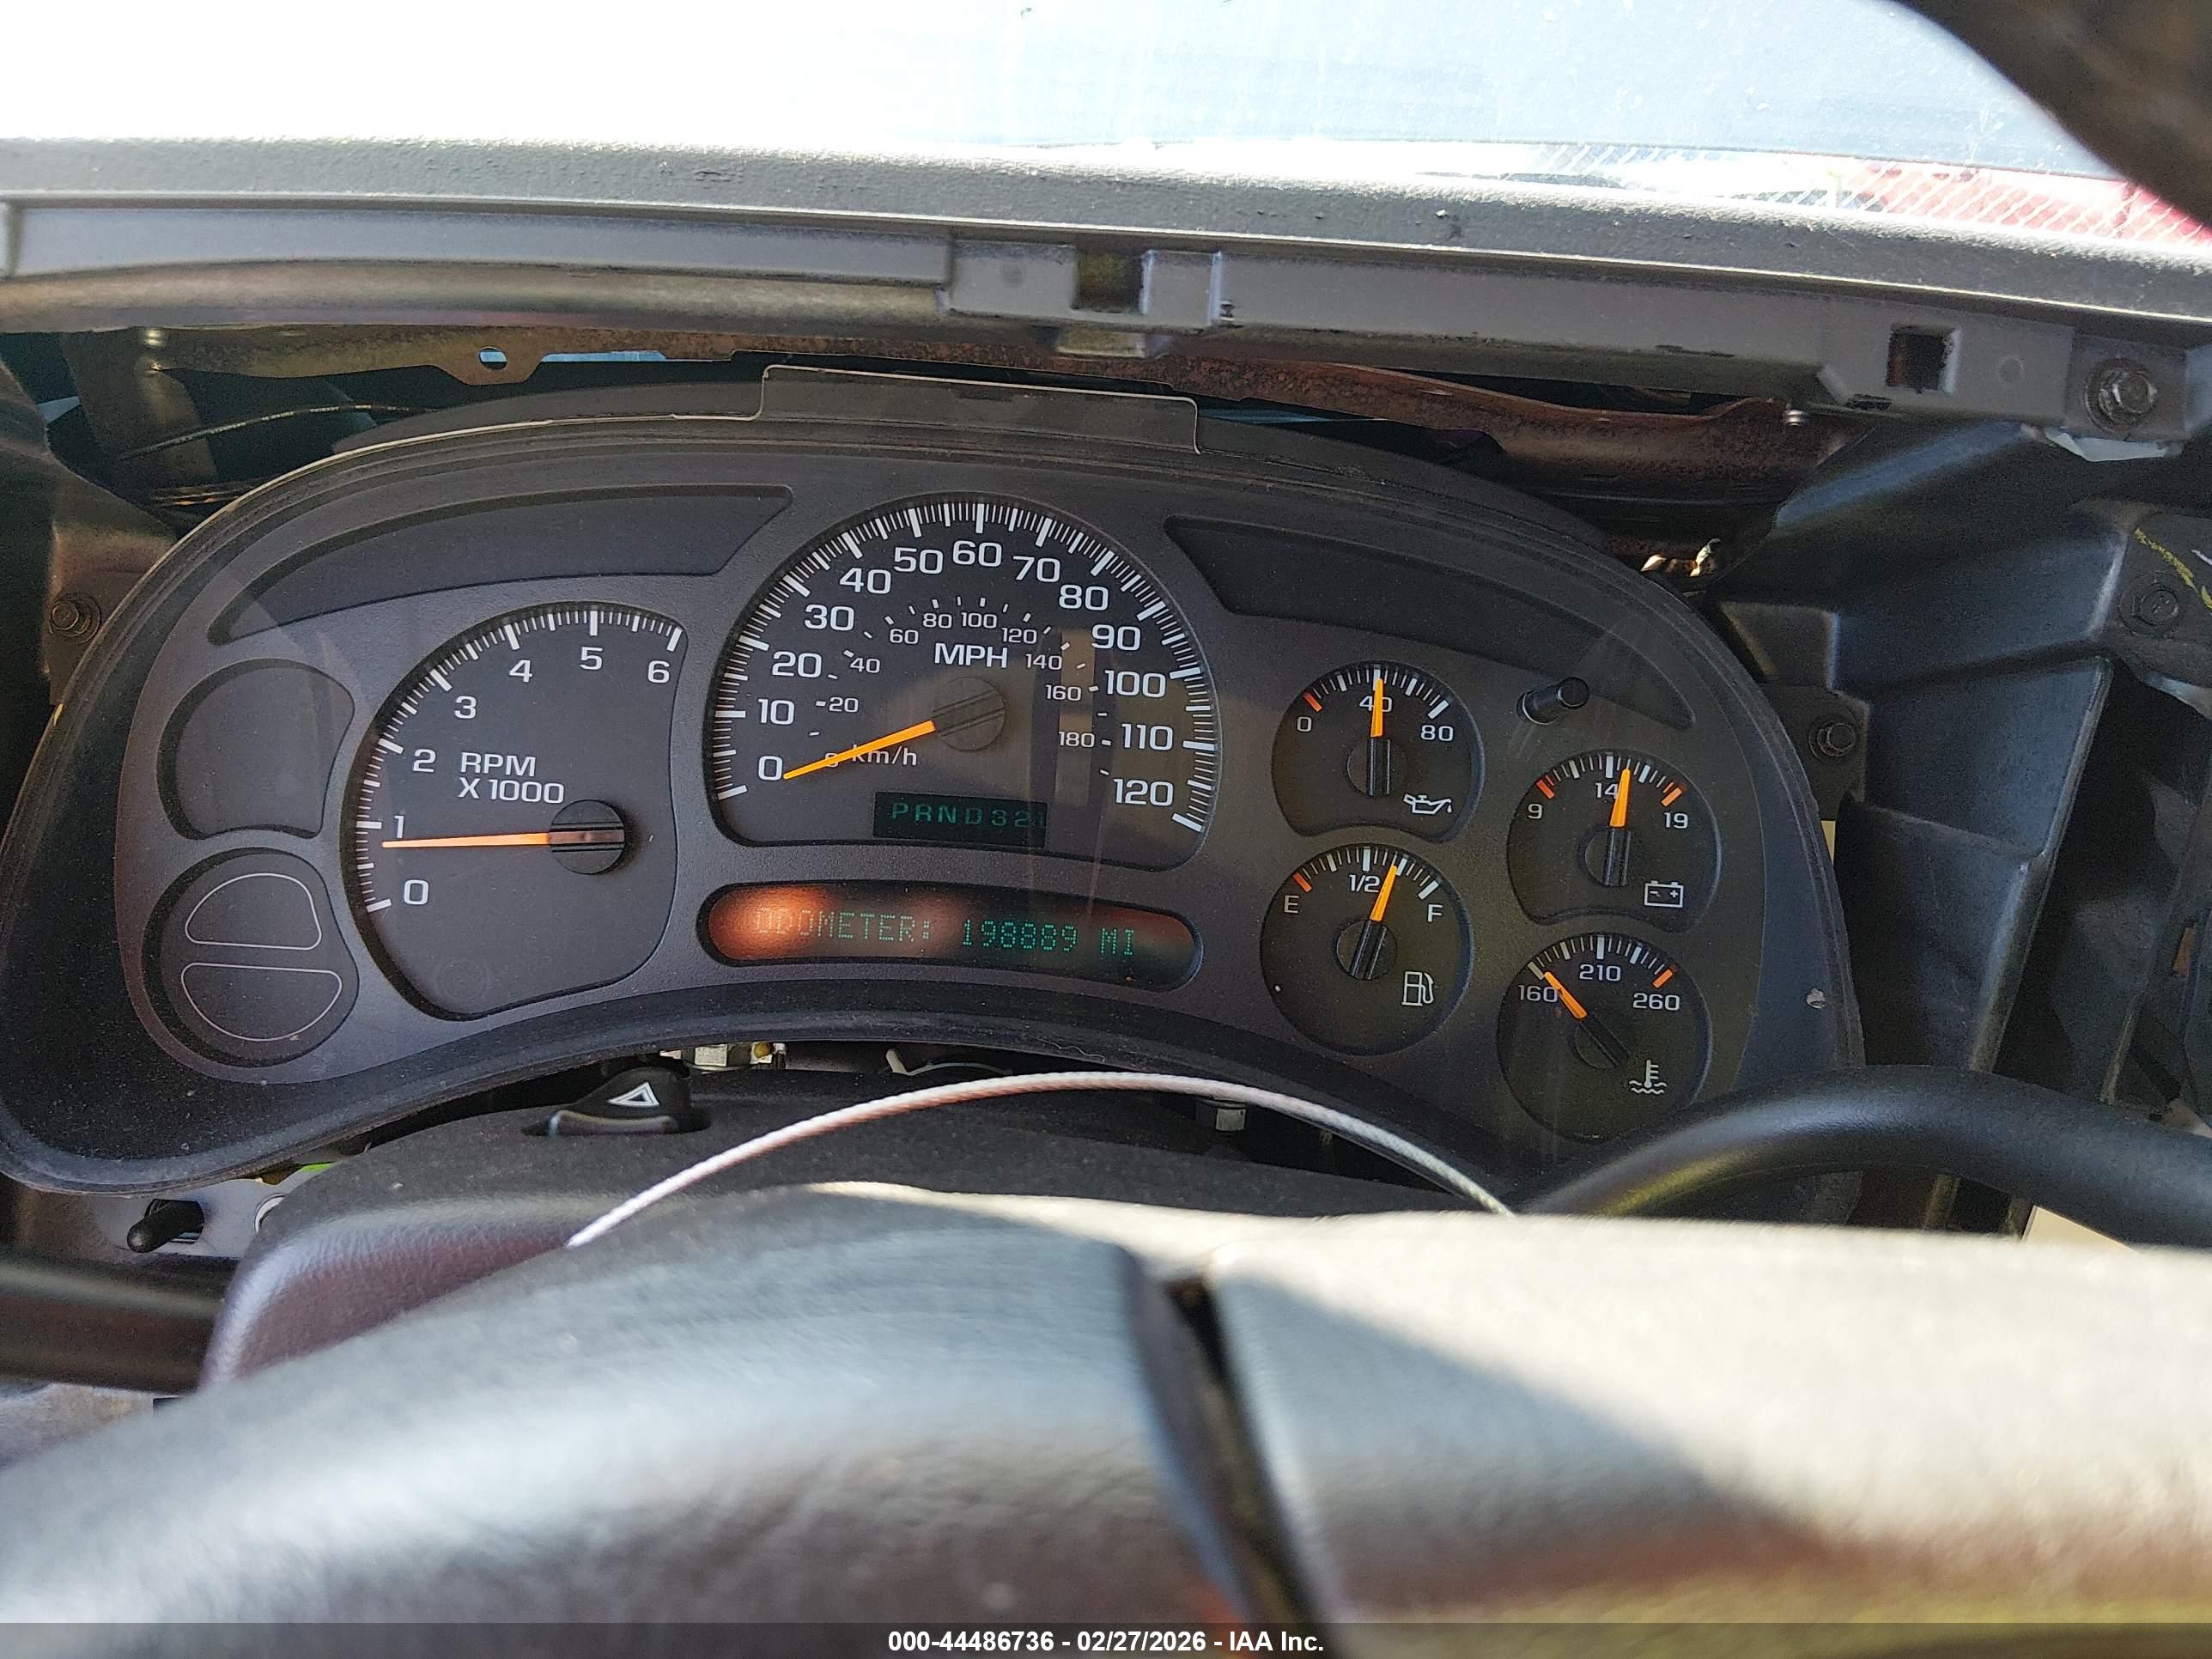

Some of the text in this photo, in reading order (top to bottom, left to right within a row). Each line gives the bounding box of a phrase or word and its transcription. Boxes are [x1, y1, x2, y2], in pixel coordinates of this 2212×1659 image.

[894, 547, 944, 574] 50
[952, 540, 1002, 567] 60
[839, 568, 891, 594] 40
[1012, 556, 1060, 583] 70
[1059, 584, 1109, 611] 80
[805, 604, 854, 631] 30
[922, 612, 952, 629] 80
[961, 611, 998, 629] 100
[890, 629, 919, 644] 60
[1001, 627, 1037, 644] 120
[1091, 625, 1141, 651] 90
[580, 647, 603, 670] 5
[772, 651, 822, 678] 20
[850, 658, 880, 673] 40
[934, 642, 1008, 668] MPH
[1025, 653, 1063, 670] 140
[509, 659, 533, 683] 4
[647, 660, 670, 684] 6
[1045, 684, 1082, 702] 160
[1104, 670, 1166, 698] 100
[454, 696, 477, 719] 3
[758, 698, 795, 725] 10
[829, 696, 859, 713] 20
[1358, 696, 1393, 713] 40
[1297, 716, 1312, 732] 0
[1420, 725, 1454, 742] 80
[1059, 731, 1095, 748] 180
[1121, 723, 1173, 750] 110
[412, 749, 436, 773] 2
[460, 751, 536, 777] RPM
[758, 756, 783, 781] 0
[1113, 778, 1174, 806] 120
[1595, 782, 1619, 799] 14
[1528, 803, 1542, 819] 9
[1664, 812, 1688, 829] 19
[394, 815, 404, 839] 1
[404, 879, 429, 905] 0
[1349, 874, 1380, 893] 1/2
[1284, 895, 1299, 914] E
[1427, 903, 1443, 922] F
[963, 919, 1077, 951] 198889
[1101, 927, 1133, 955] MI
[1579, 963, 1621, 981] 210
[1518, 985, 1558, 1003] 160
[1632, 993, 1680, 1011] 260
